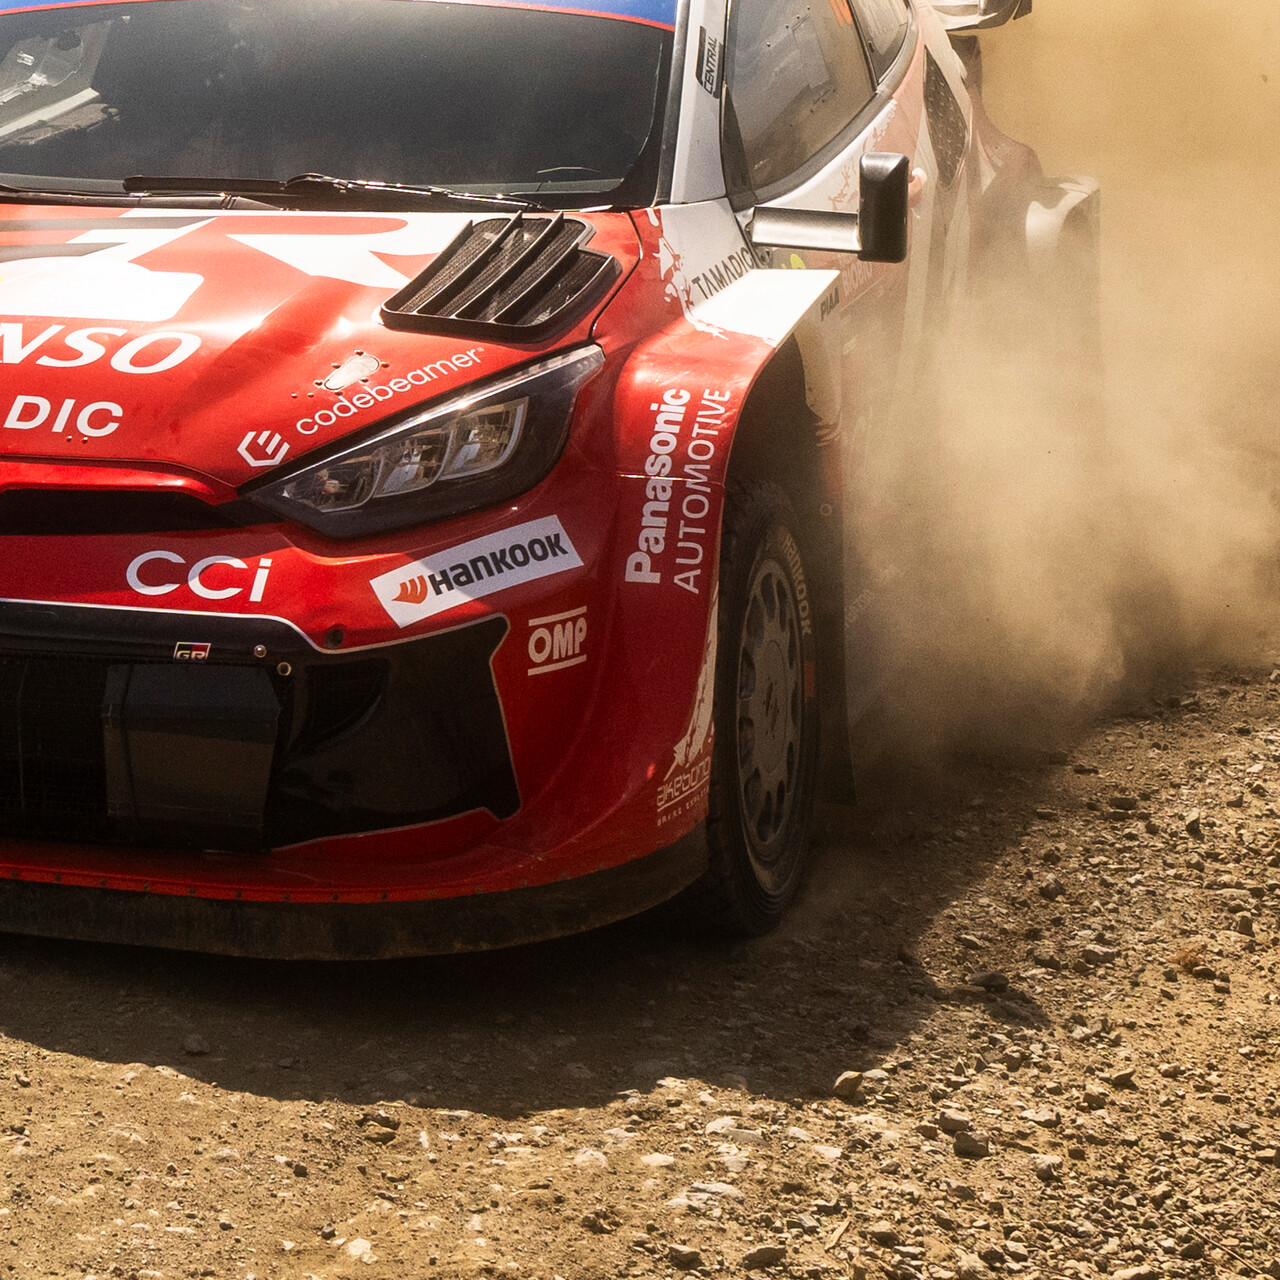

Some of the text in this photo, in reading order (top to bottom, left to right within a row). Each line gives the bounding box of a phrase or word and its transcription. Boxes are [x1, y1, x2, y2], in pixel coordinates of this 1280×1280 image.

[703, 36, 717, 95] CENTRAL
[691, 246, 754, 299] TAMADIC
[624, 388, 691, 585] Panasonic
[673, 388, 731, 595] AUTOMOTIVE
[527, 617, 588, 664] OMP
